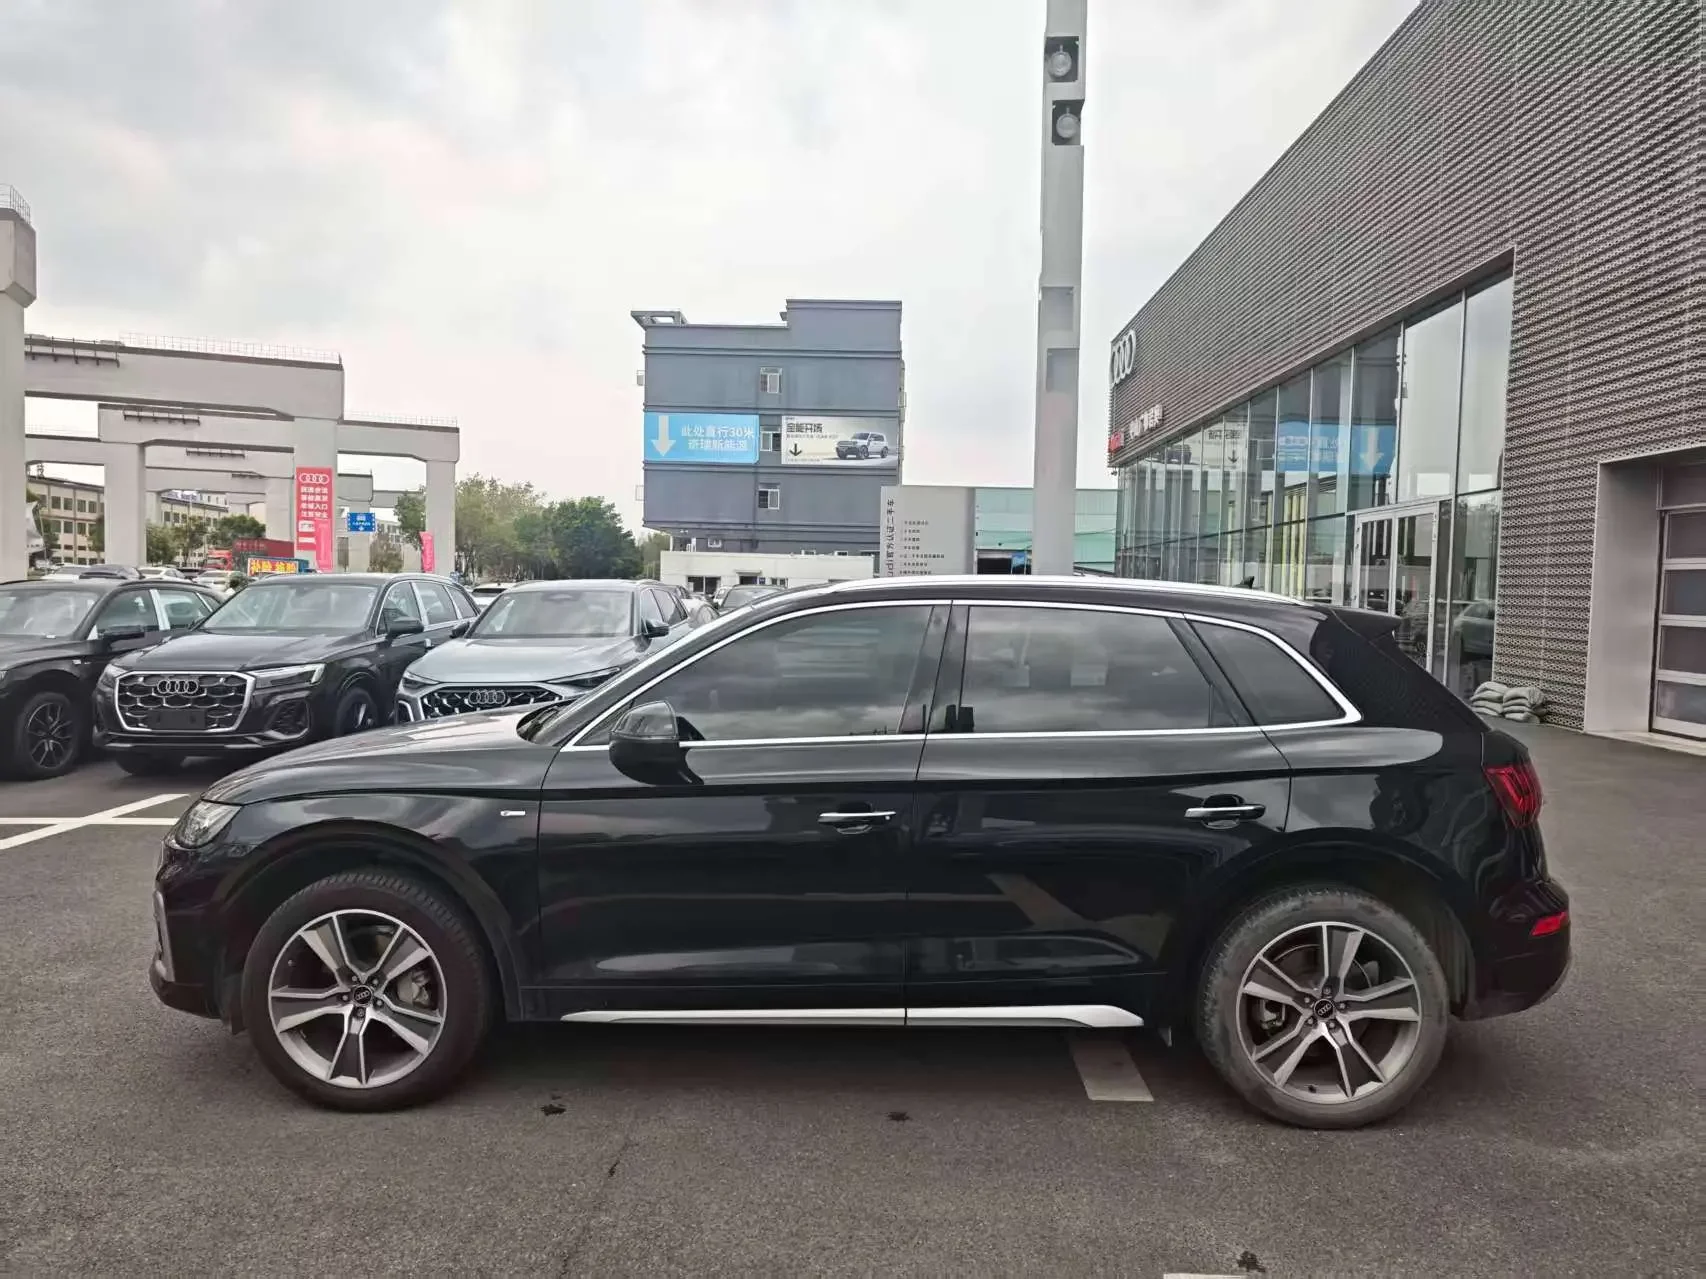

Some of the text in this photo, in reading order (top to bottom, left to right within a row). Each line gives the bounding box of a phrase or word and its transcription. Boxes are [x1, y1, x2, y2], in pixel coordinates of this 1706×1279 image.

[886, 499, 895, 577] udi官方认证二手车
